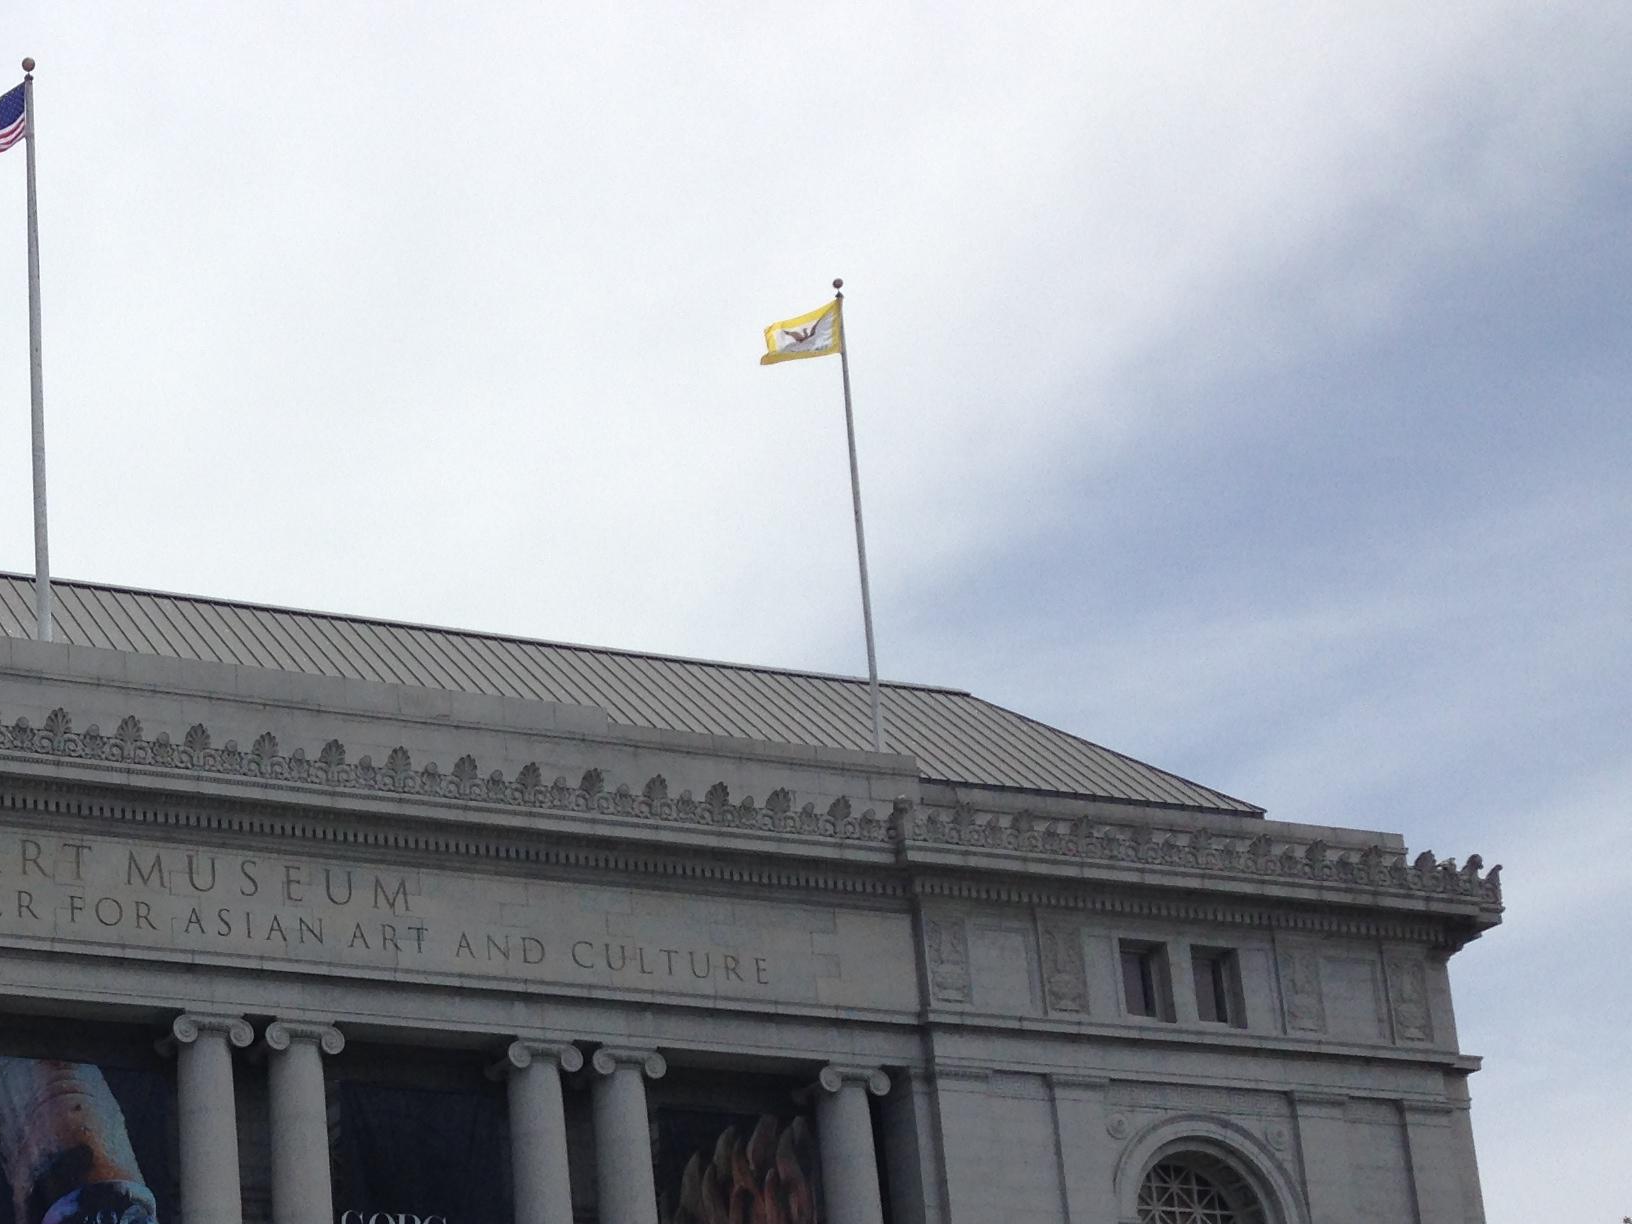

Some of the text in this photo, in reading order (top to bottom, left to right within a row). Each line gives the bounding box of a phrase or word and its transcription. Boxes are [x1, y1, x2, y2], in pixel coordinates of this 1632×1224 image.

[125, 850, 412, 914] MUSEUM
[68, 894, 159, 930] FOR
[184, 907, 325, 947] ASIAN
[348, 921, 429, 956] ART
[455, 930, 545, 966] AND
[571, 940, 769, 985] CULTURE
